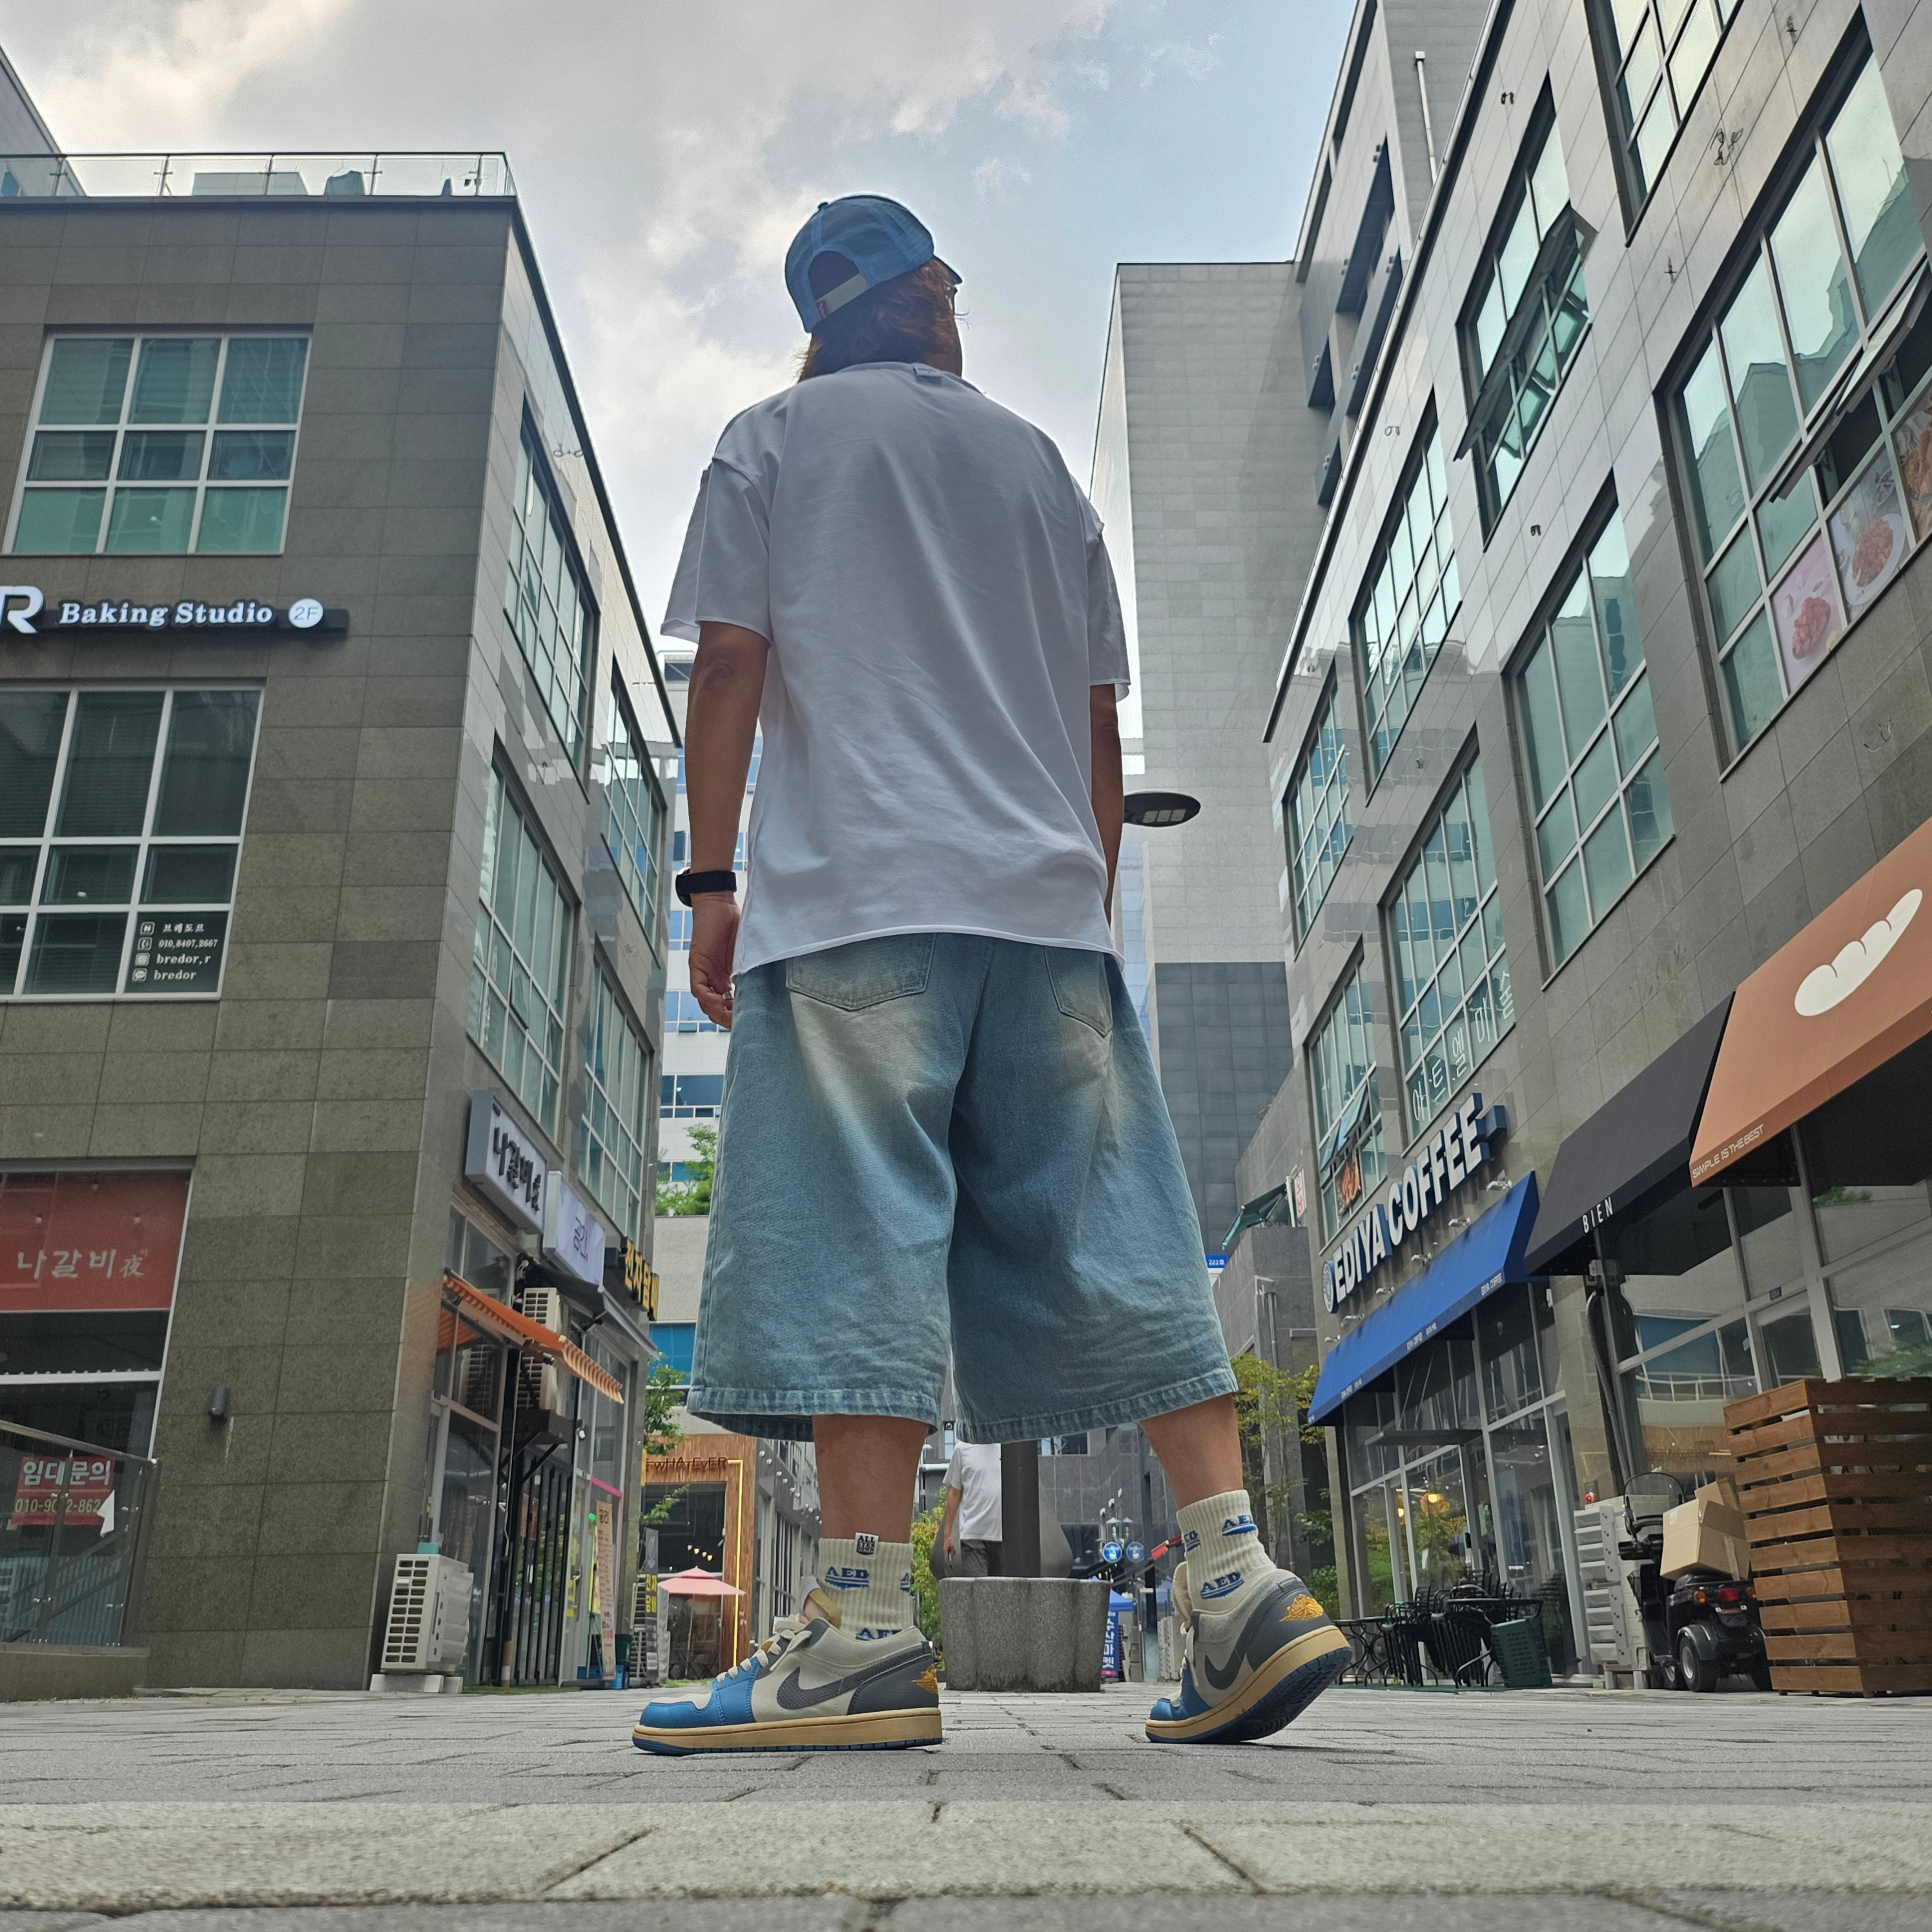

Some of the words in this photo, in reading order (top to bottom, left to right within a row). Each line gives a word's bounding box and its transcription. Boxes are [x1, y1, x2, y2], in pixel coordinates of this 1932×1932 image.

[59, 601, 169, 628] Baking
[174, 601, 274, 624] Studio
[294, 606, 320, 621] 2F
[154, 969, 197, 980] bredor
[1692, 1153, 1720, 1179] SIMPLE
[1721, 1148, 1729, 1160] IS
[1728, 1138, 1745, 1155] THE
[1743, 1124, 1764, 1146] BEST
[1332, 1203, 1388, 1303] EDIYA
[1387, 1093, 1489, 1246] COFFEE
[1582, 1196, 1613, 1234] BIEN
[23, 1461, 65, 1485] 임대
[70, 1460, 111, 1485] 문의
[15, 1497, 101, 1514] 010-902-862
[826, 1566, 870, 1579] AED
[1200, 1571, 1241, 1593] AED
